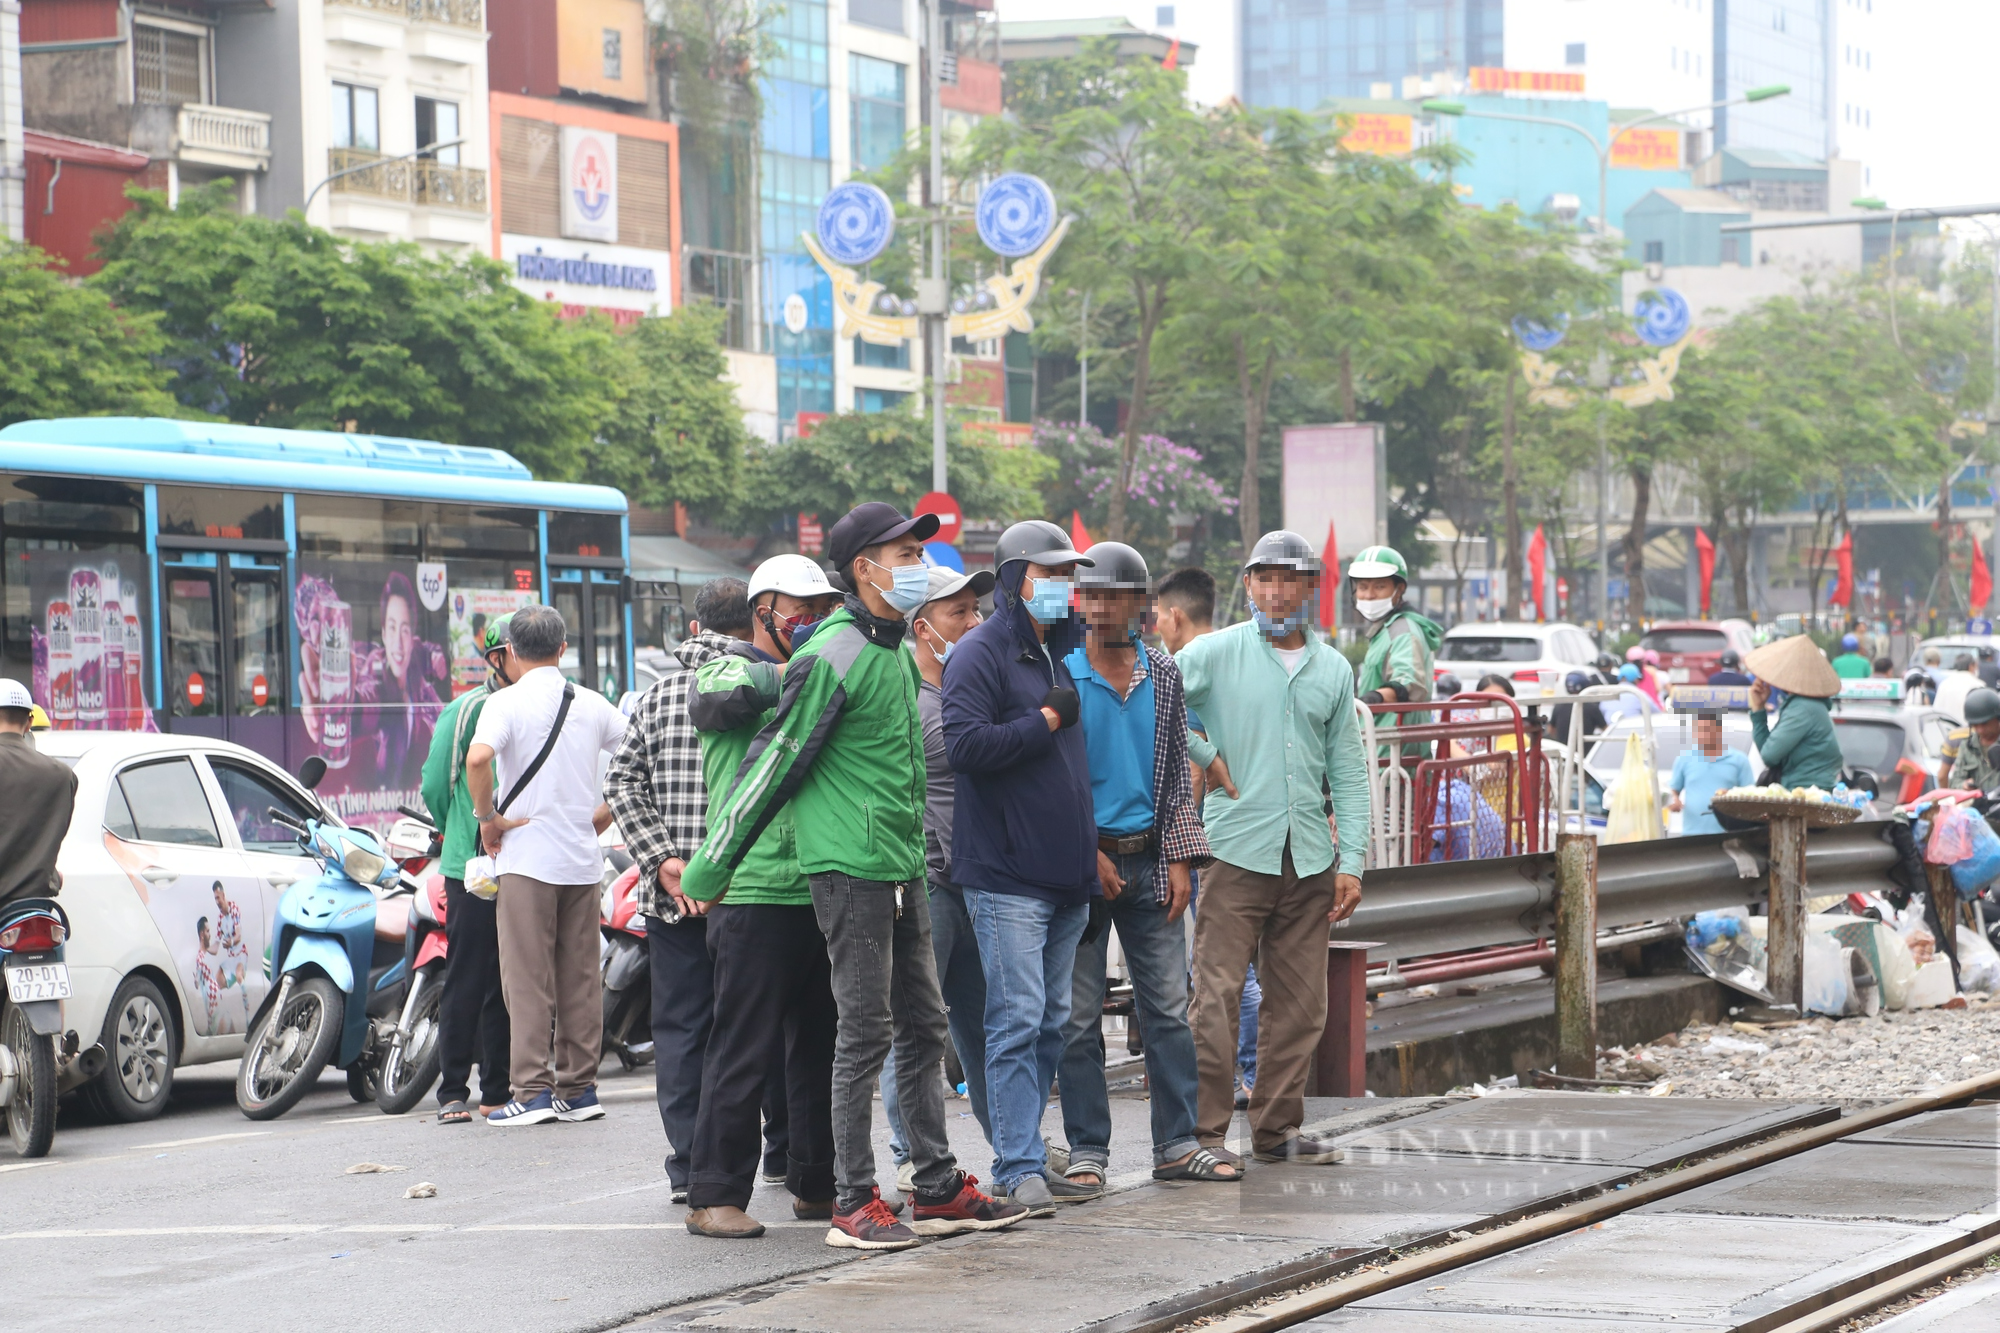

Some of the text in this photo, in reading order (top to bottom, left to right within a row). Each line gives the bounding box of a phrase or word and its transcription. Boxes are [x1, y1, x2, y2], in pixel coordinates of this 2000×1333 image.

[1613, 144, 1678, 158] HOTEL
[622, 266, 657, 291] KHOA
[77, 691, 103, 708] NHO
[324, 722, 346, 738] NHO
[776, 731, 800, 753] Grab
[16, 966, 58, 983] 20-D1
[13, 982, 68, 999] 072.75
